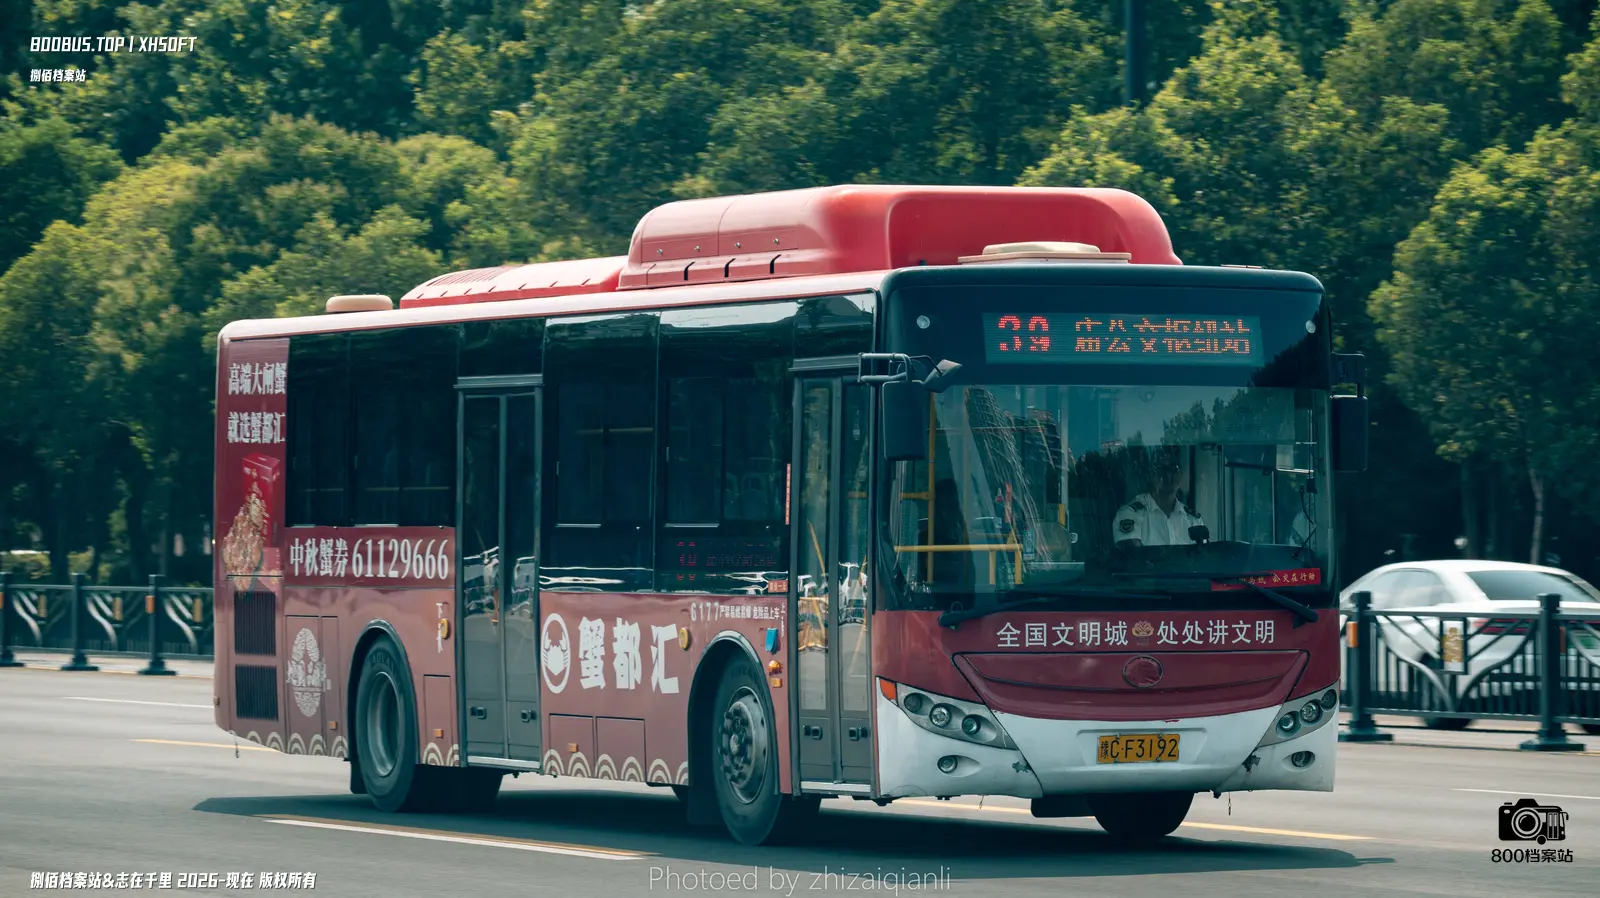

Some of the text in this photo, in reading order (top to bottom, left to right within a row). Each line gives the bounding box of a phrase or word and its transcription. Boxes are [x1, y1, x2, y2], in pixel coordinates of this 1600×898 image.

[998, 315, 1050, 353] 39
[228, 362, 288, 396] 高端大闸蟹
[227, 411, 286, 444] 就选蟹都汇
[290, 537, 450, 580] 中秋蟹券 61129666
[691, 601, 720, 621] 6177
[996, 619, 1275, 648] 全国文明城 处处讲文明
[578, 616, 680, 694] 蟹都汇
